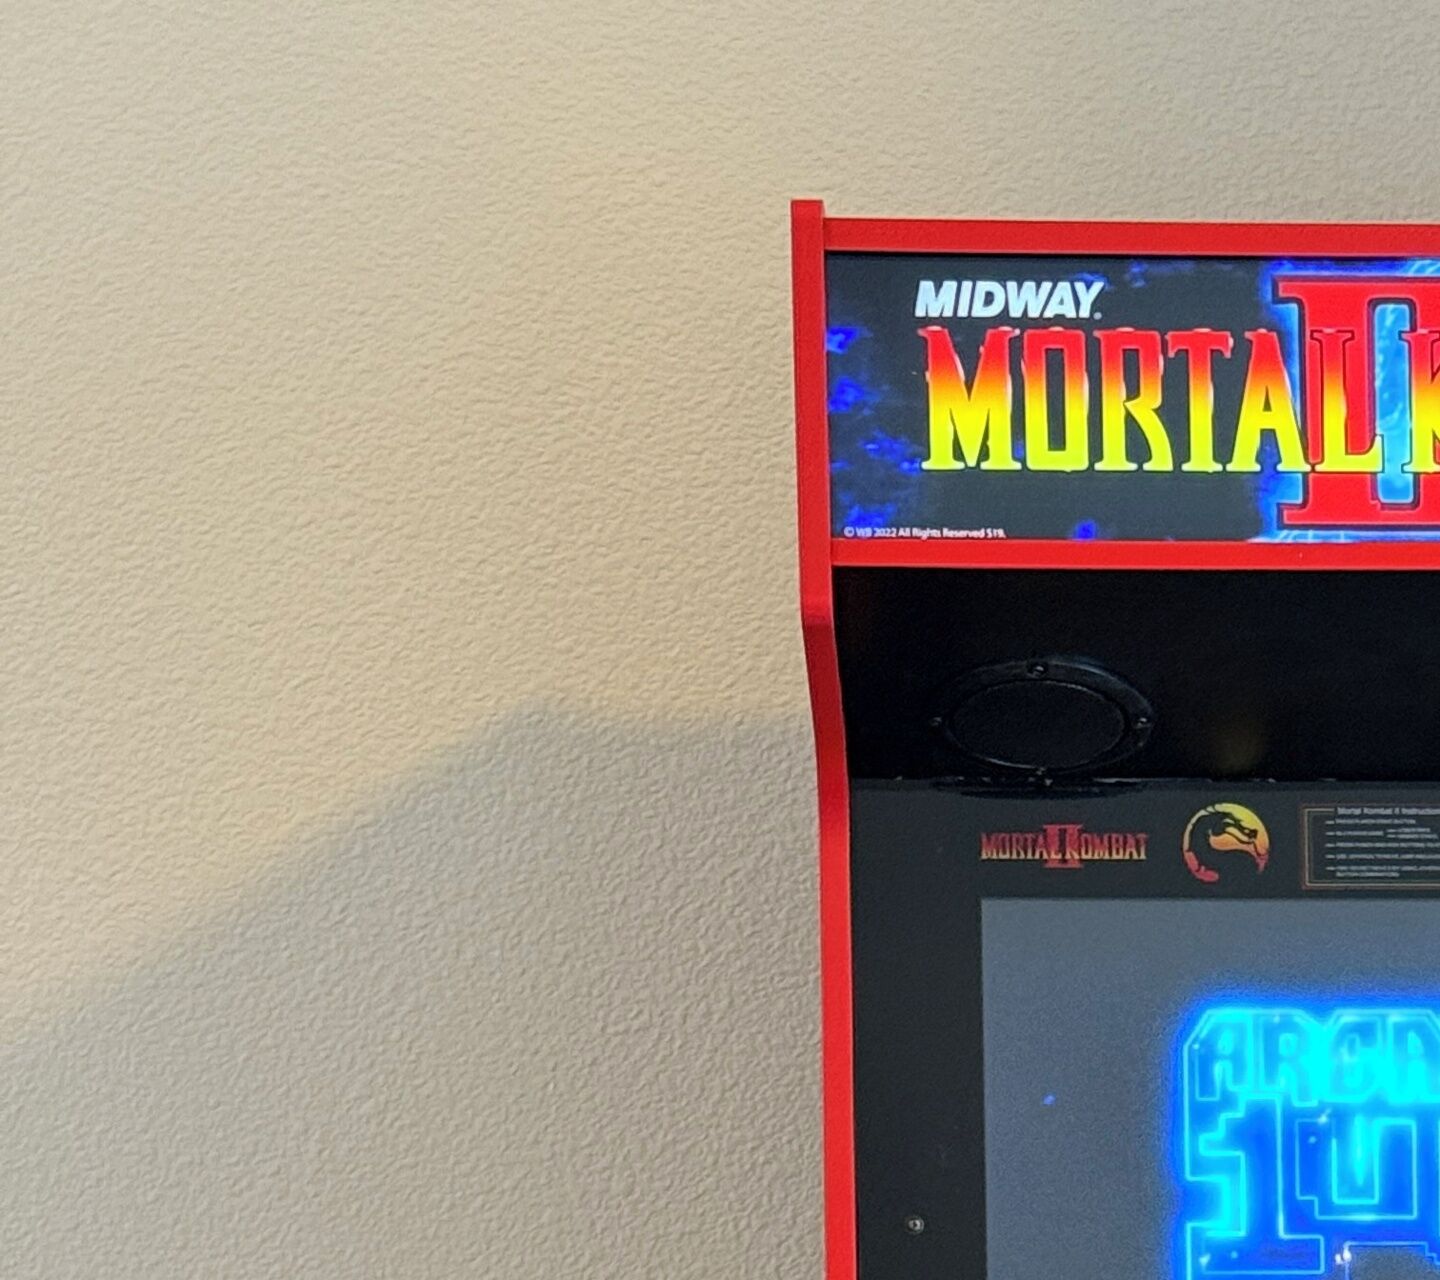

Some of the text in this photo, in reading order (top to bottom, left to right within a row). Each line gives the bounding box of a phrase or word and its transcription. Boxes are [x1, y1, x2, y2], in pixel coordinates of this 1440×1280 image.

[918, 326, 1384, 472] MORTAL
[912, 527, 941, 541] Rights
[943, 527, 984, 538] Reserved
[980, 833, 1064, 860] MORTAL
[1064, 833, 1147, 860] KOMBAT
